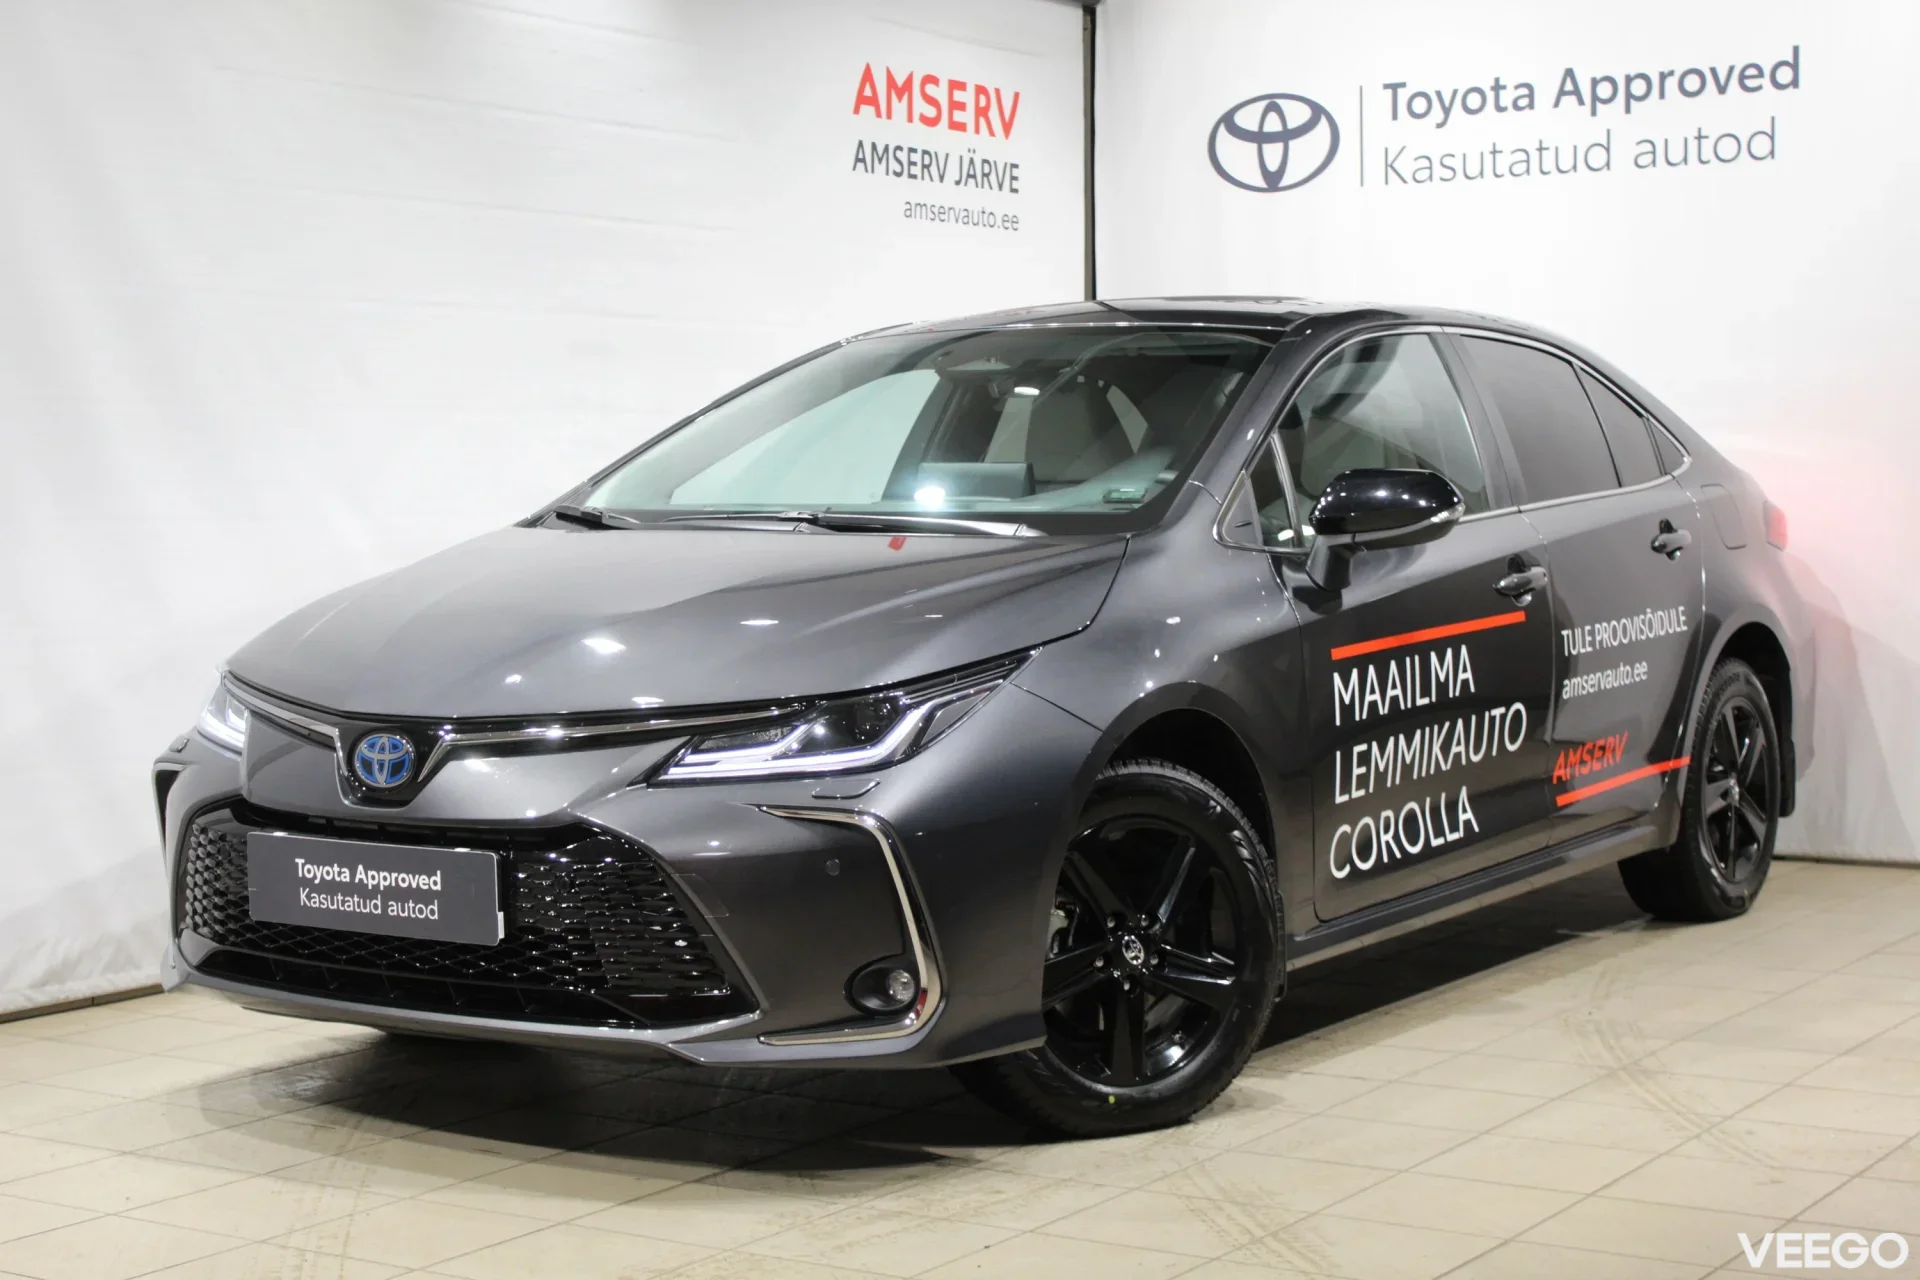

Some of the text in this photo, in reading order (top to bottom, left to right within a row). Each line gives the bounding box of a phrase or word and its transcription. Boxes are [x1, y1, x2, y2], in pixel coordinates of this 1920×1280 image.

[852, 61, 1020, 140] AMSERV
[1382, 44, 1801, 130] Toyota Approved
[852, 139, 1020, 194] AMSERV JÄRVE
[1383, 115, 1778, 186] Kasutatud autod
[903, 200, 1020, 231] amservauto.ee
[1560, 605, 1688, 657] TULE PROOVISÕIDULE
[1332, 643, 1476, 726] MAAILMA
[1562, 660, 1648, 700] amservauto.ee
[1334, 701, 1528, 804] LEMMIKAUTO
[1552, 731, 1628, 785] AMSERV
[1329, 785, 1480, 879] COROLLA
[294, 858, 442, 891] Toyota Approved
[299, 887, 439, 920] Kasutatud autod
